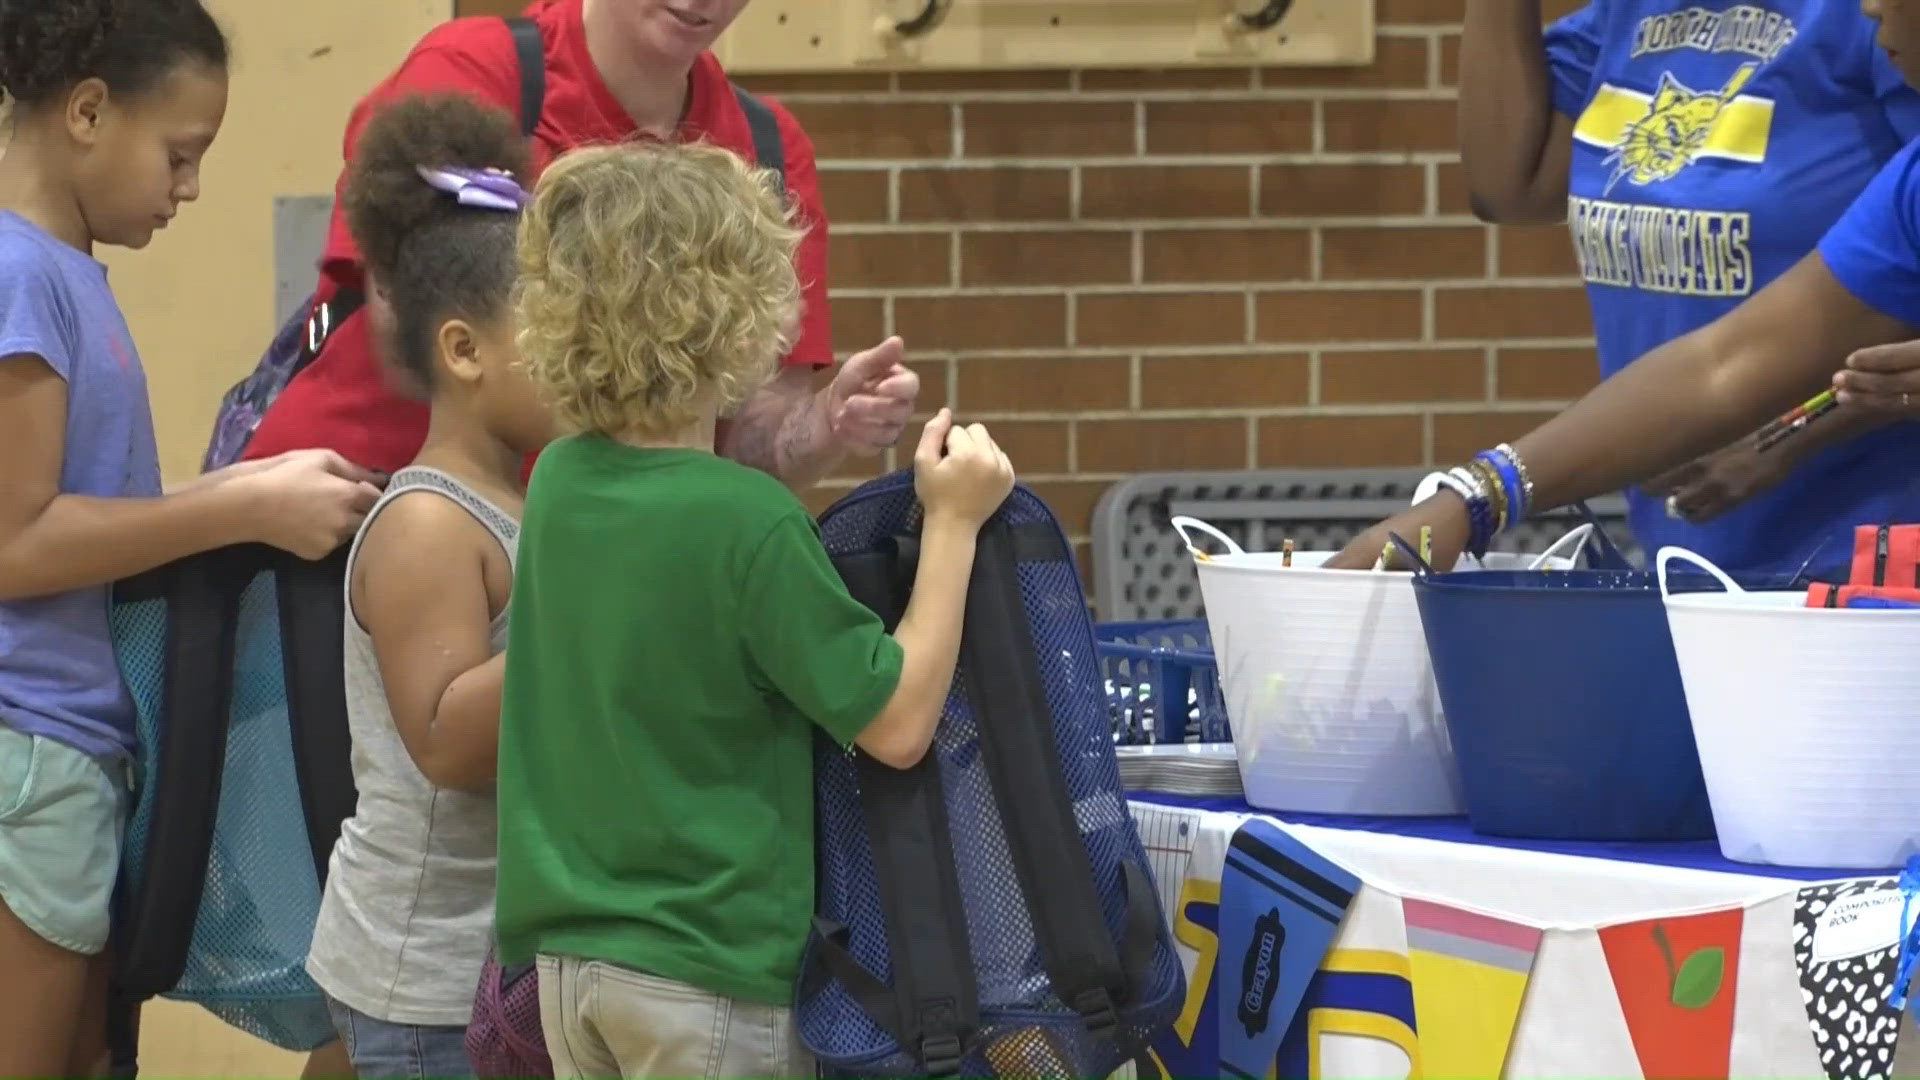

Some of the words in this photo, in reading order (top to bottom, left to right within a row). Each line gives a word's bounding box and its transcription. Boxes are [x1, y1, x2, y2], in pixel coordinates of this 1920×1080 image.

[1630, 203, 1751, 296] WILDCATS
[1828, 912, 1859, 928] BOOK
[1245, 932, 1276, 1013] Crayon
